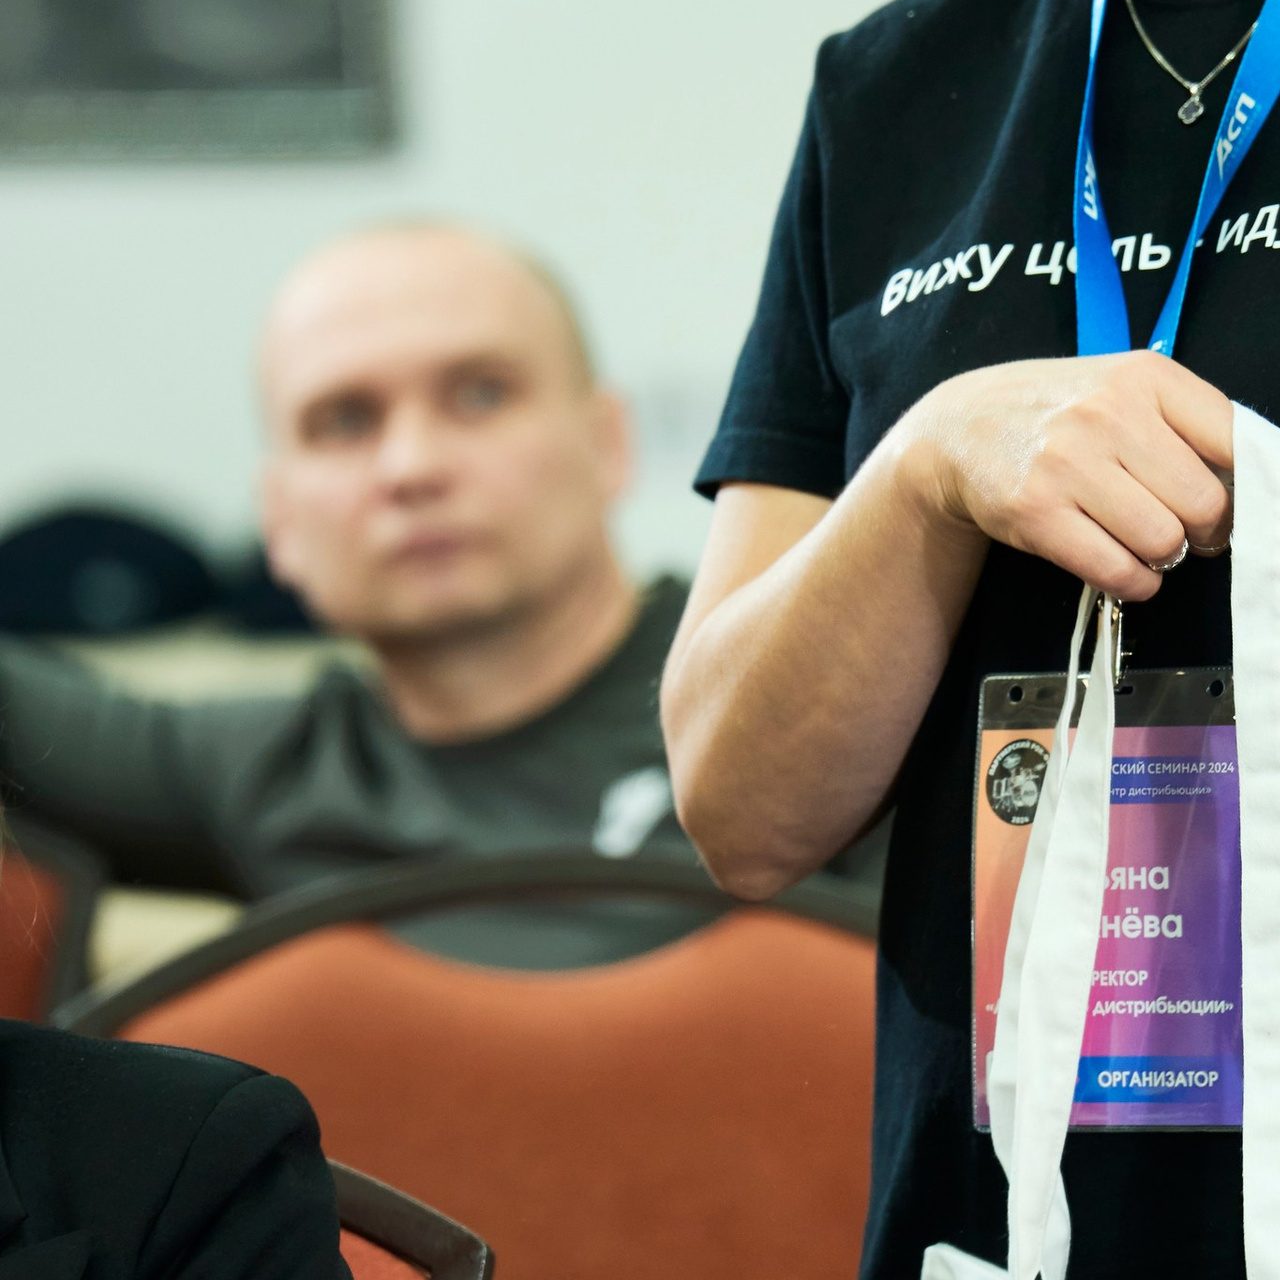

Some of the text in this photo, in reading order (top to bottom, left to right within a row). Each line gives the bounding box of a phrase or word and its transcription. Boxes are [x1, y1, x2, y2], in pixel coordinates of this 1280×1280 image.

[880, 243, 1015, 318] Вижу
[1111, 761, 1235, 775] СКИЙ СЕМИНАР 2024
[1100, 907, 1183, 939] нёва
[1091, 970, 1149, 986] РЕКТОР
[1092, 996, 1235, 1018] дистрибьюции»
[1098, 1071, 1219, 1089] ОРГАНИЗАТОР
